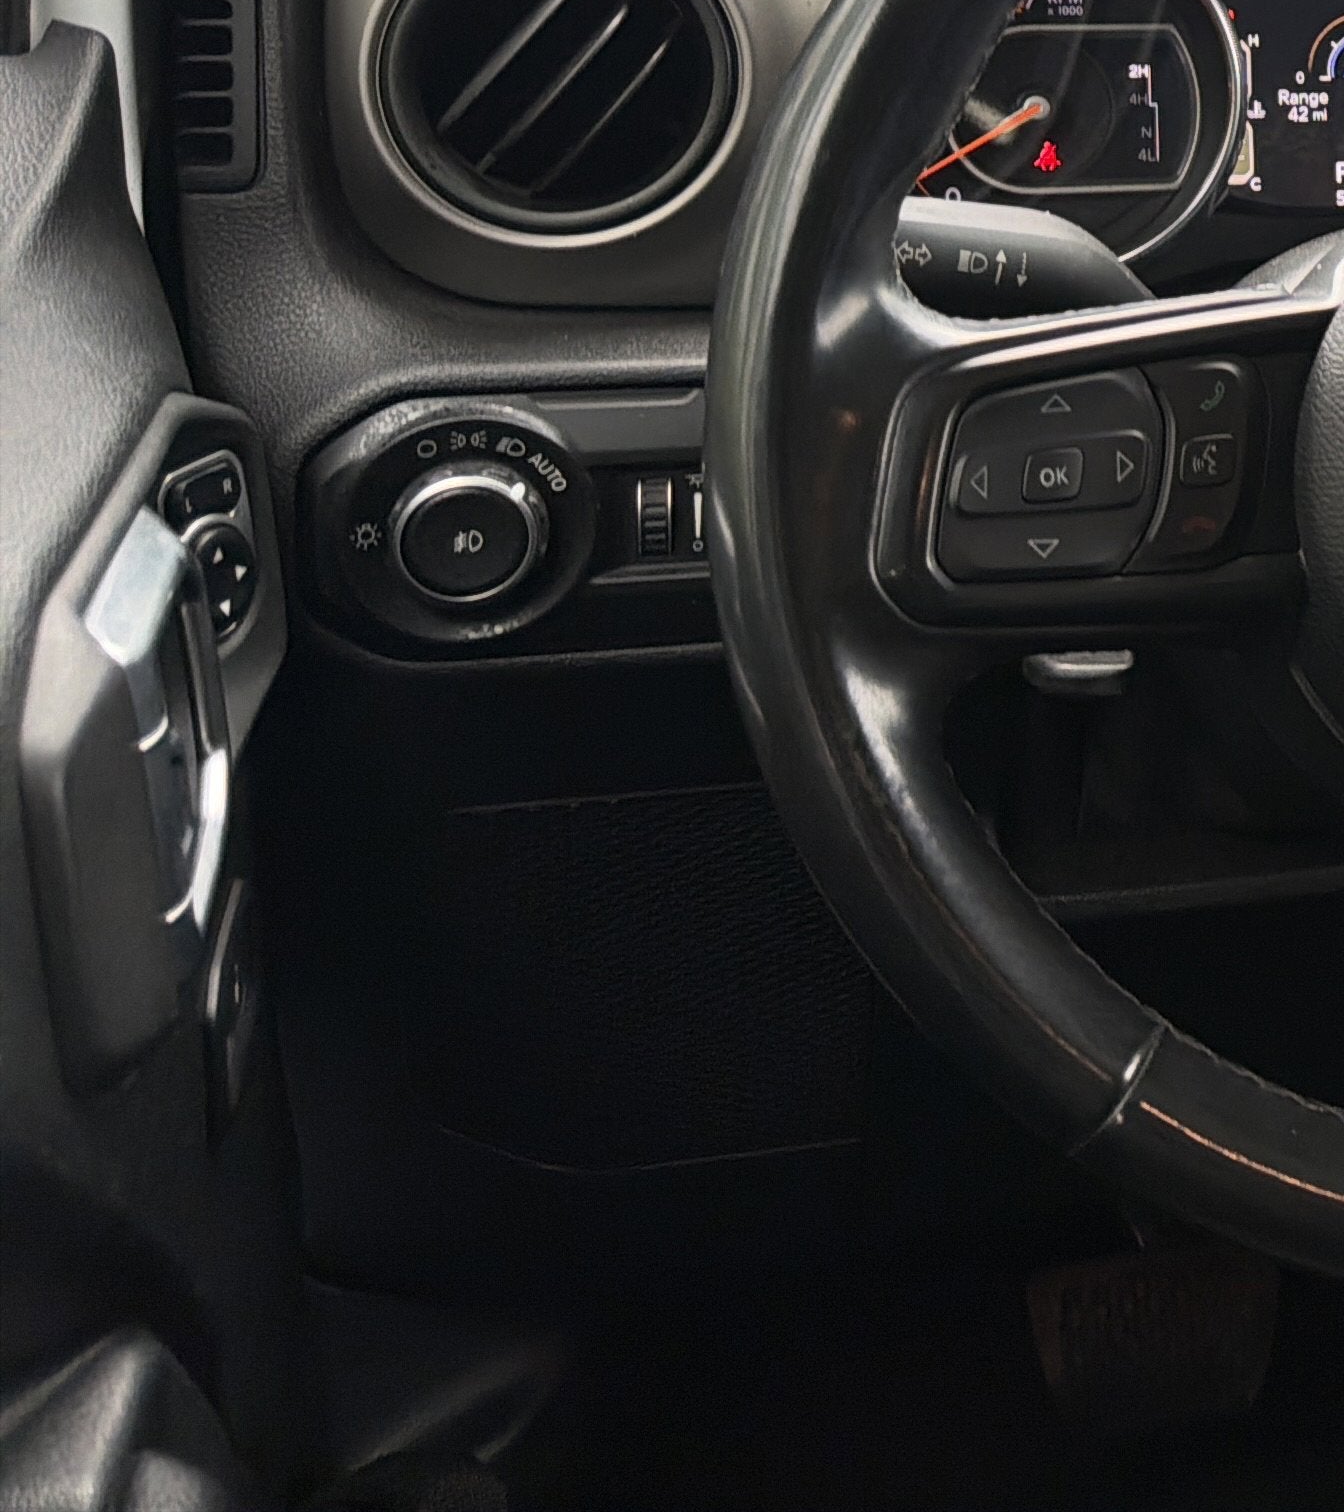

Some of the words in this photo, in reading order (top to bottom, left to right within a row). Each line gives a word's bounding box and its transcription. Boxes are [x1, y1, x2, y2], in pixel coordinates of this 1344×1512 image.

[1057, 5, 1084, 16] 1000
[1248, 34, 1260, 47] H
[1128, 64, 1150, 79] 2H
[1295, 71, 1305, 85] 0
[1129, 92, 1148, 106] 4H
[1277, 88, 1329, 109] Range
[1287, 106, 1309, 123] 42
[1312, 107, 1328, 122] mi
[1141, 125, 1153, 138] N
[1138, 148, 1156, 162] 4L
[1250, 176, 1262, 192] C
[528, 452, 567, 493] AUTO
[1039, 464, 1071, 489] OK
[223, 478, 233, 494] R
